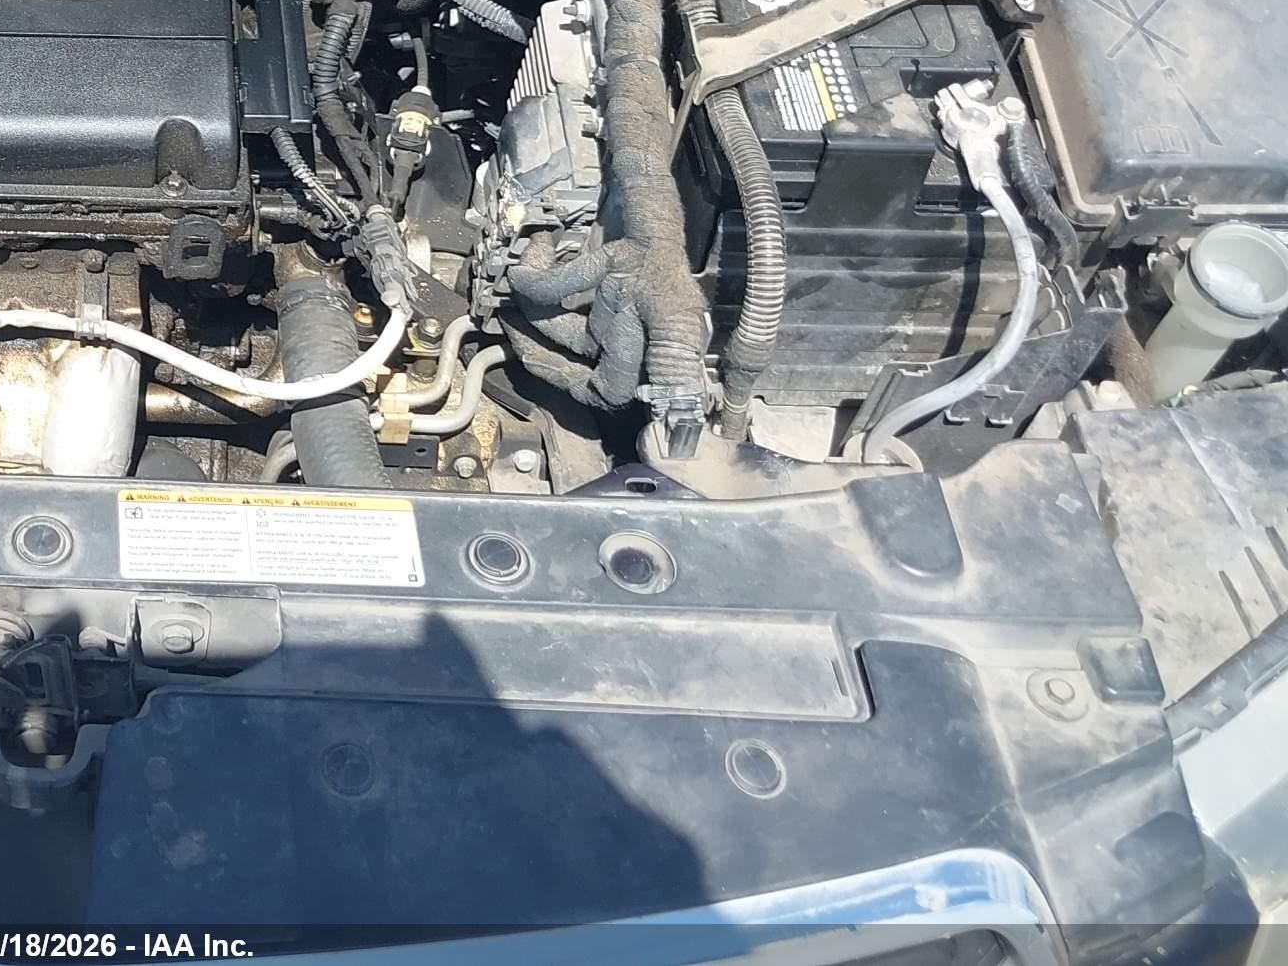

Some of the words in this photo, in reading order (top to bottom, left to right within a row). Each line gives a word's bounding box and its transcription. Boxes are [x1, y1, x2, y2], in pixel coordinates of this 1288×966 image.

[136, 493, 170, 501] WARNING
[188, 495, 233, 503] ADVERTENCIA
[302, 499, 357, 507] AVERTISSEMENT
